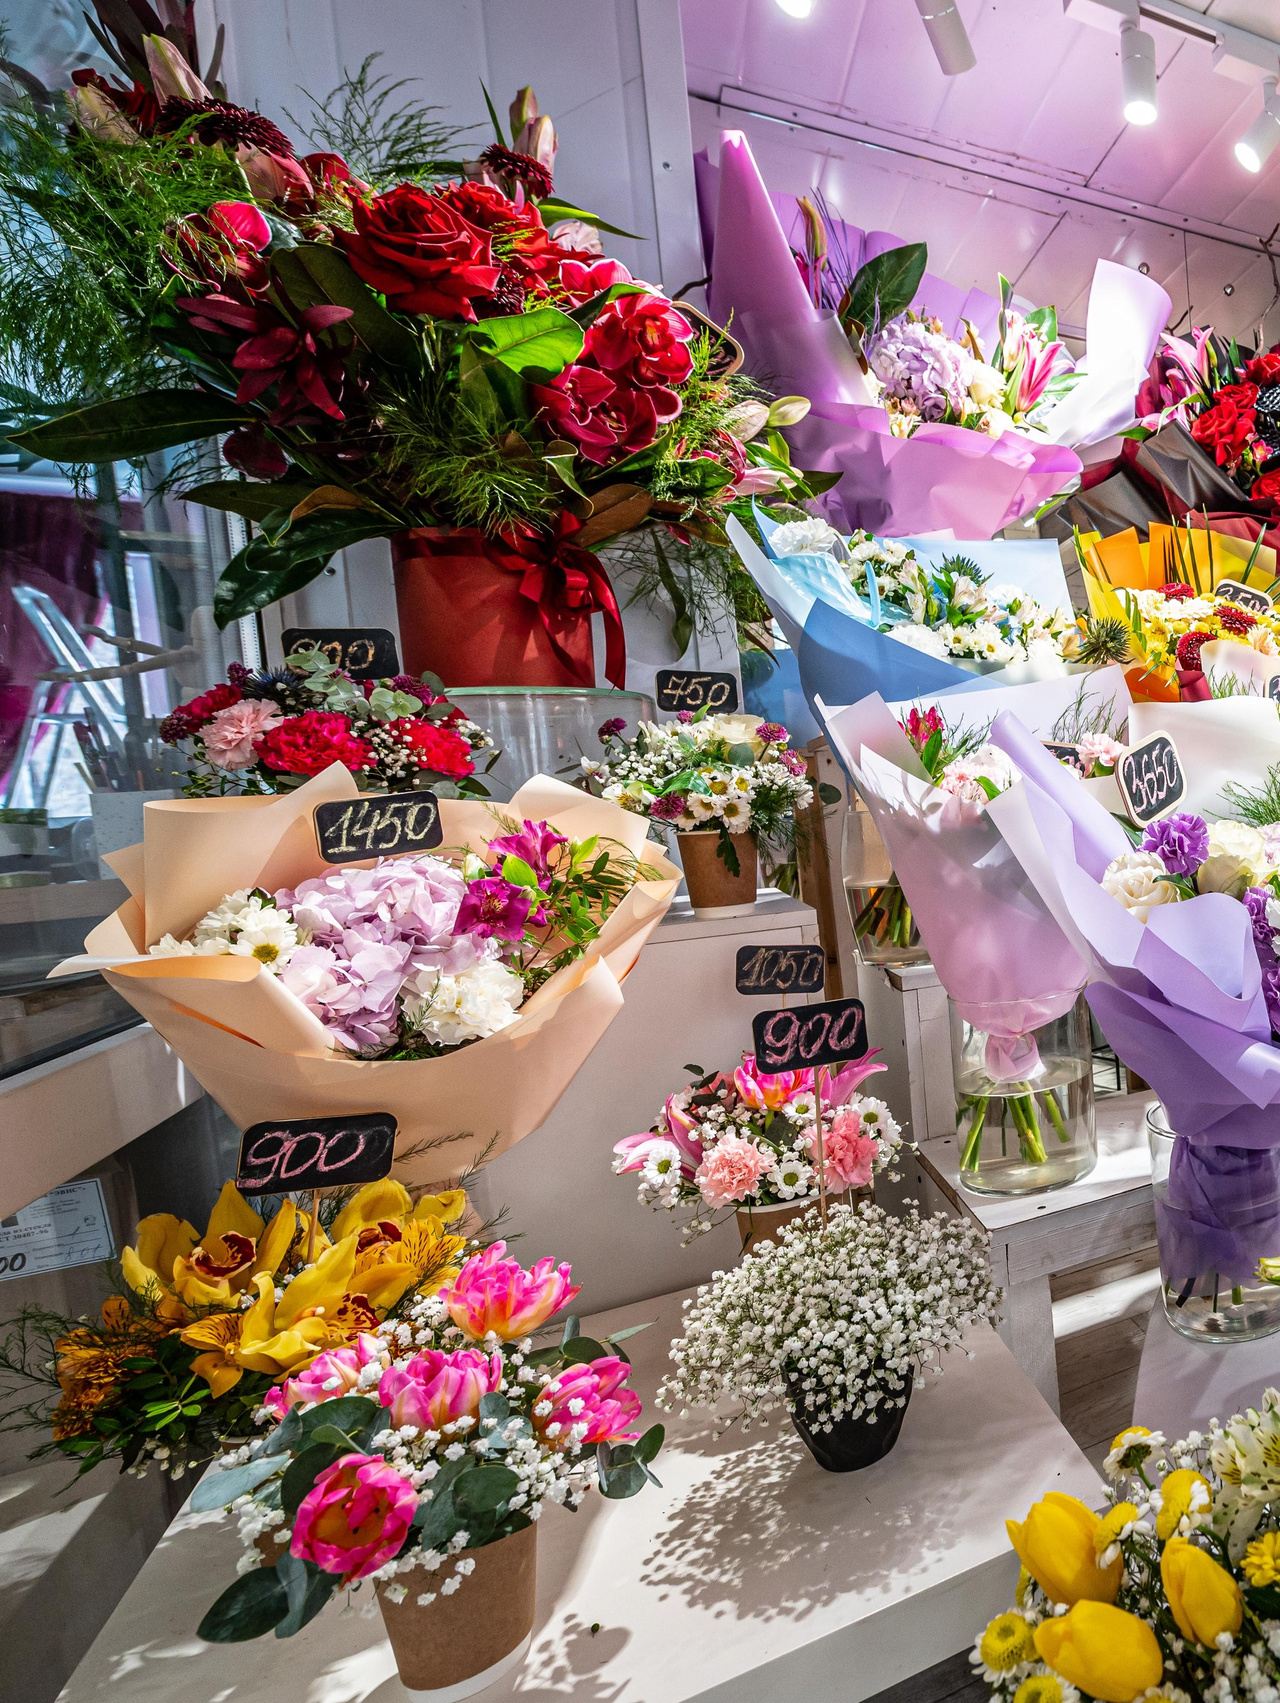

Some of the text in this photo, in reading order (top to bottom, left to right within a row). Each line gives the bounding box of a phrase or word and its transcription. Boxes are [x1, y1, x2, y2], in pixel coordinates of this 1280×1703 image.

[663, 675, 731, 706] 750
[324, 801, 437, 854] 1450
[738, 947, 823, 989] 1050
[763, 1006, 863, 1065] 900
[236, 1130, 366, 1188] 900
